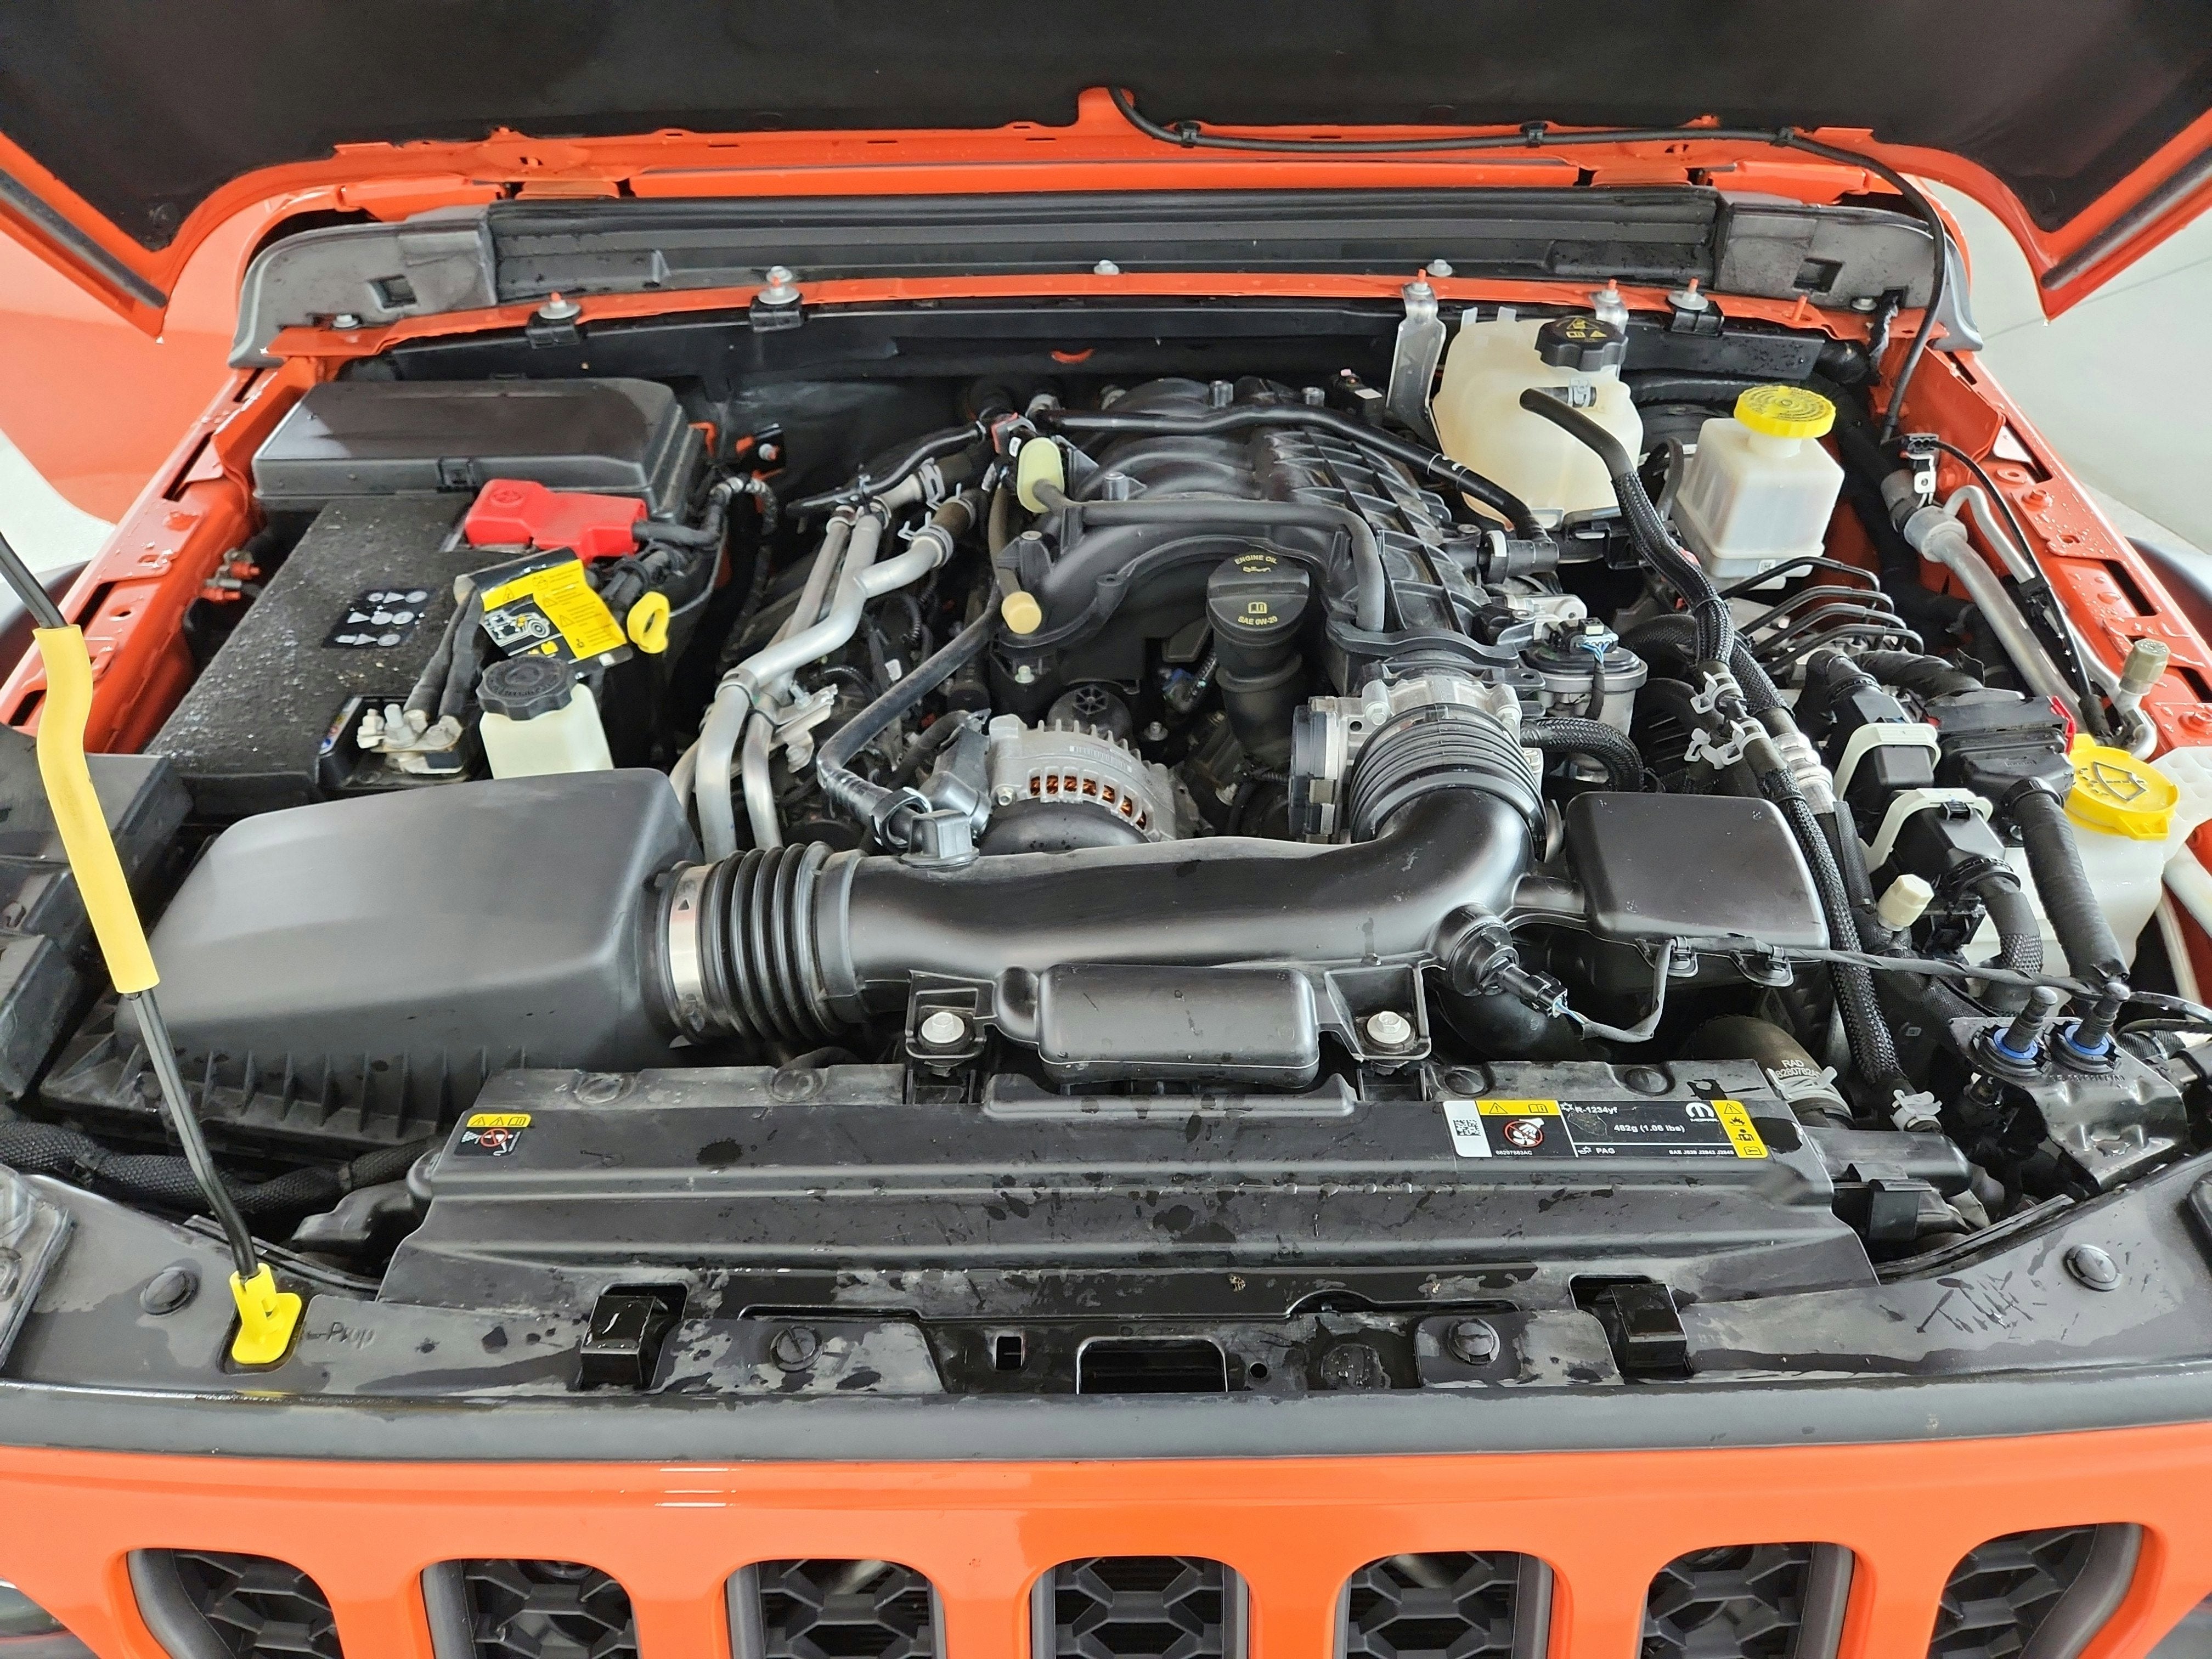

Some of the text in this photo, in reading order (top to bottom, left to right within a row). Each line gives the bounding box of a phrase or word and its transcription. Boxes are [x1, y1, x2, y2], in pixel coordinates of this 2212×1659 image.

[1234, 555, 1264, 565] ENGINE
[1238, 616, 1278, 625] SAE 0W-20
[1781, 1059, 1805, 1068] RAD
[1575, 1106, 1618, 1115] R-1234yf
[1613, 1125, 1686, 1133] 482g (1.06 lbs)
